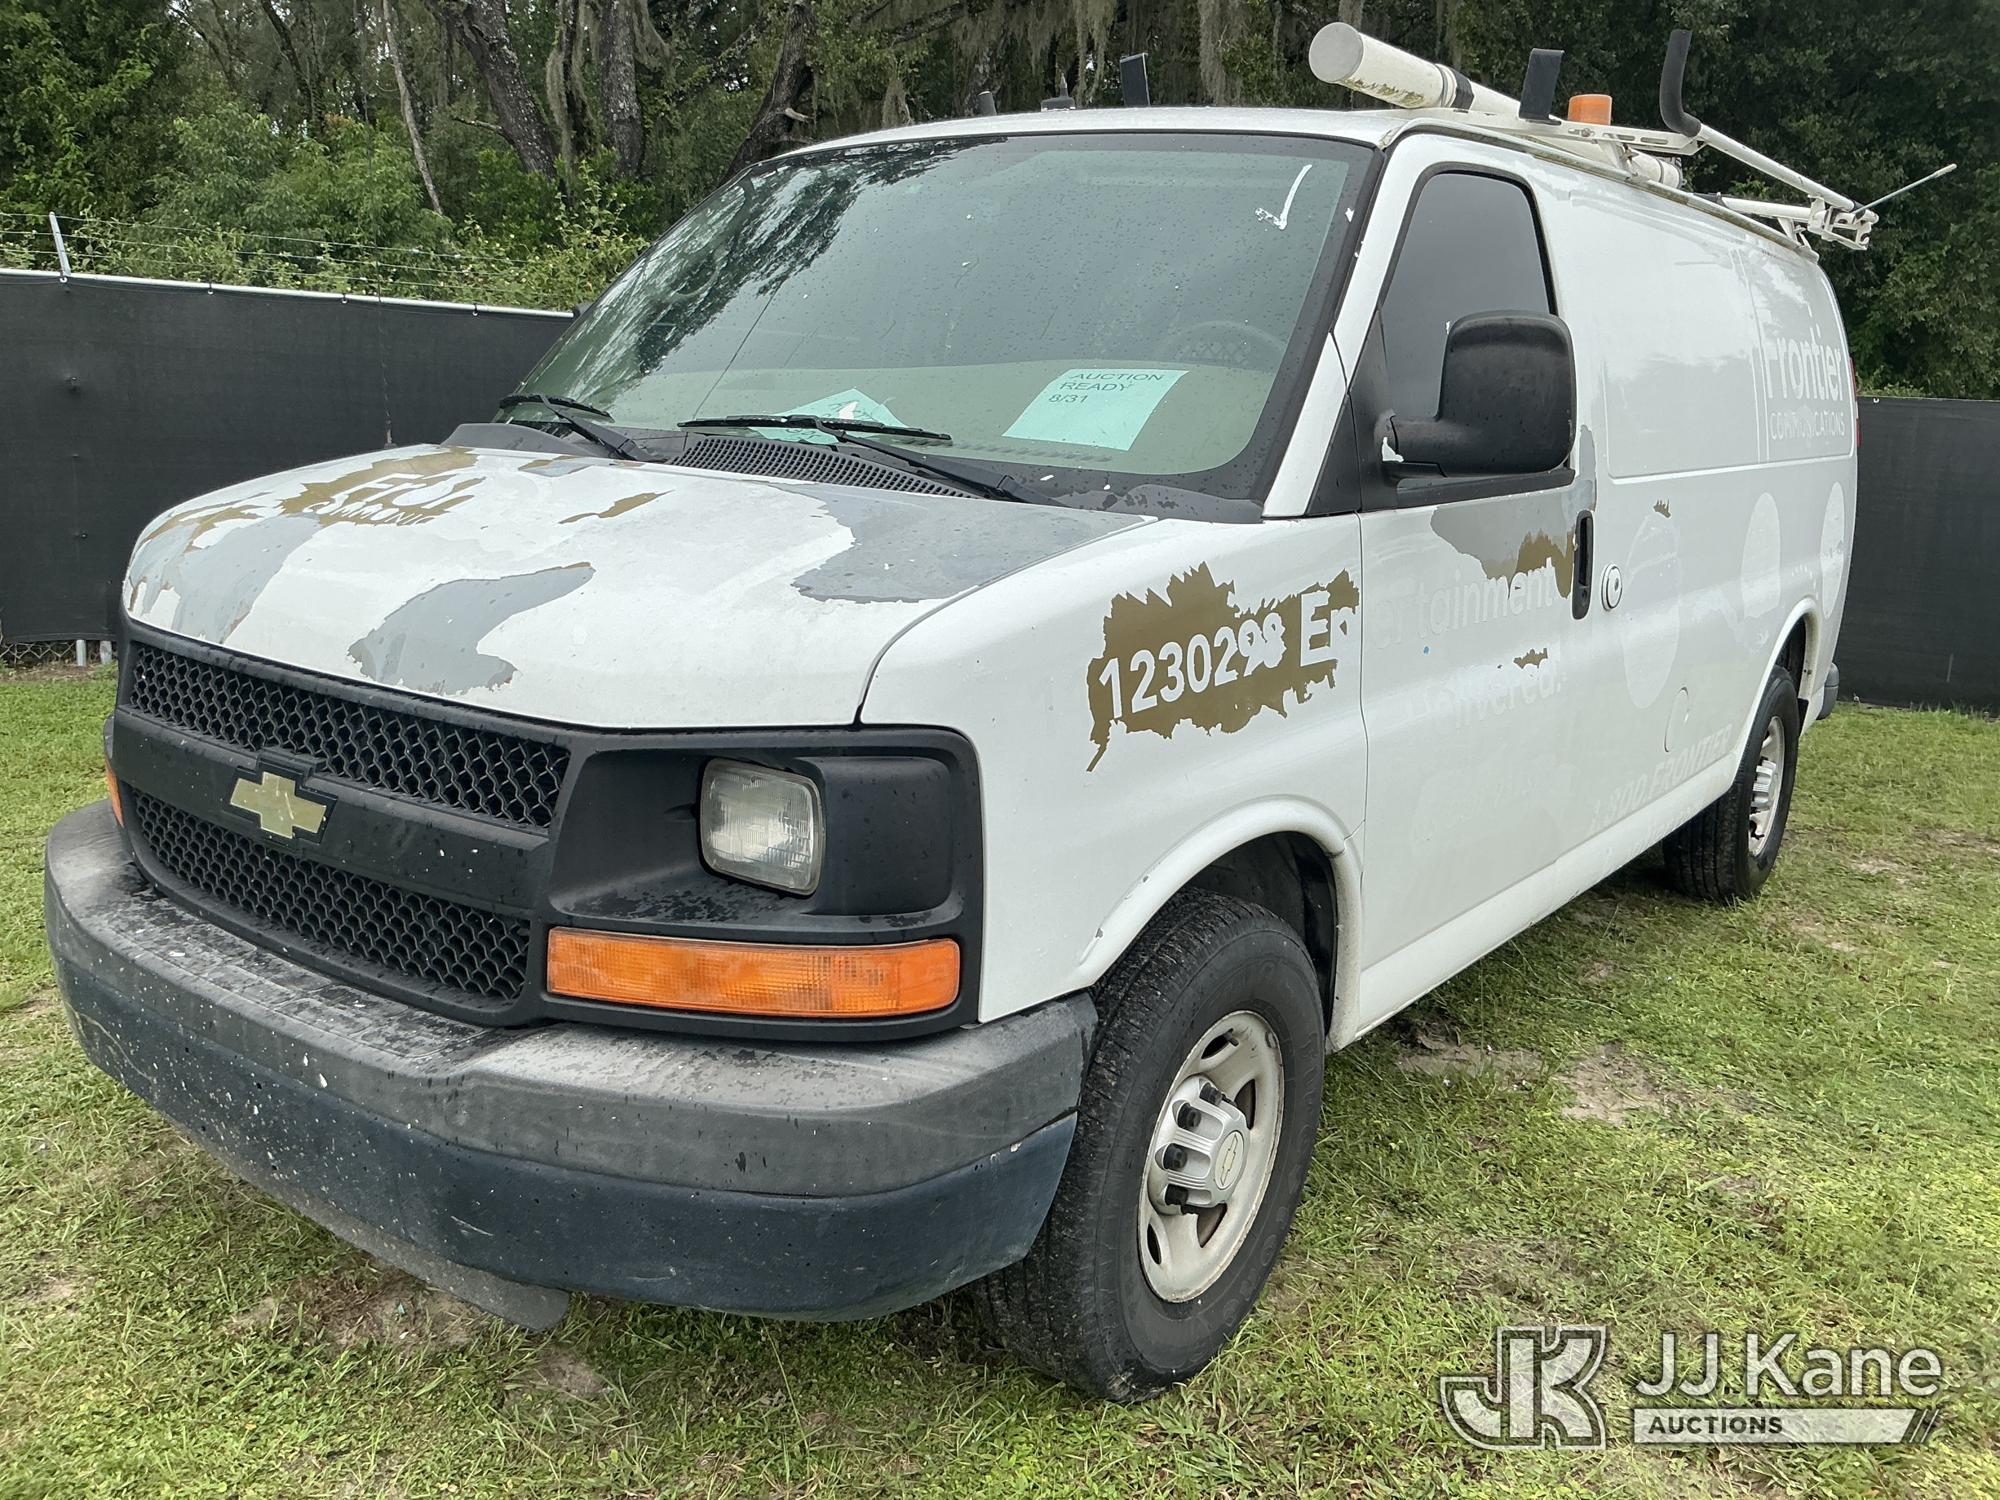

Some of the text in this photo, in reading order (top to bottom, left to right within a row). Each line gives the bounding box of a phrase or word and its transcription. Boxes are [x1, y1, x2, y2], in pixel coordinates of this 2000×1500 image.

[1071, 373, 1164, 381] AUCTION
[1060, 382, 1132, 391] READY
[1048, 394, 1089, 404] 8/31
[1098, 612, 1287, 719] 1230298
